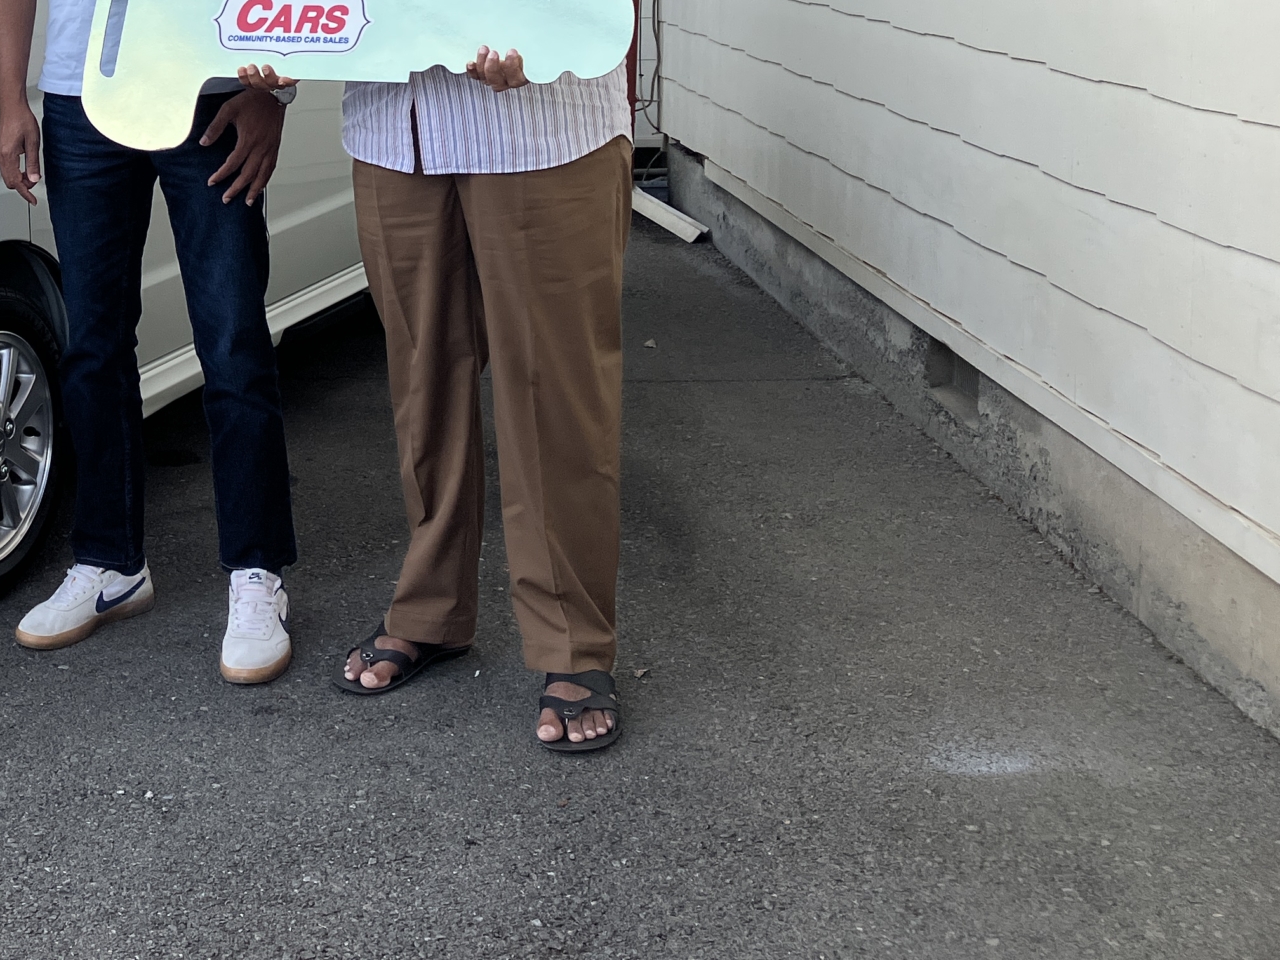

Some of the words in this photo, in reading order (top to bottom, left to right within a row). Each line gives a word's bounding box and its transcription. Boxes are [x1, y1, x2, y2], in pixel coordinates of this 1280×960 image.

[227, 34, 302, 43] COMMUNITY-BASED
[304, 36, 321, 44] CAR
[322, 36, 349, 44] SALES
